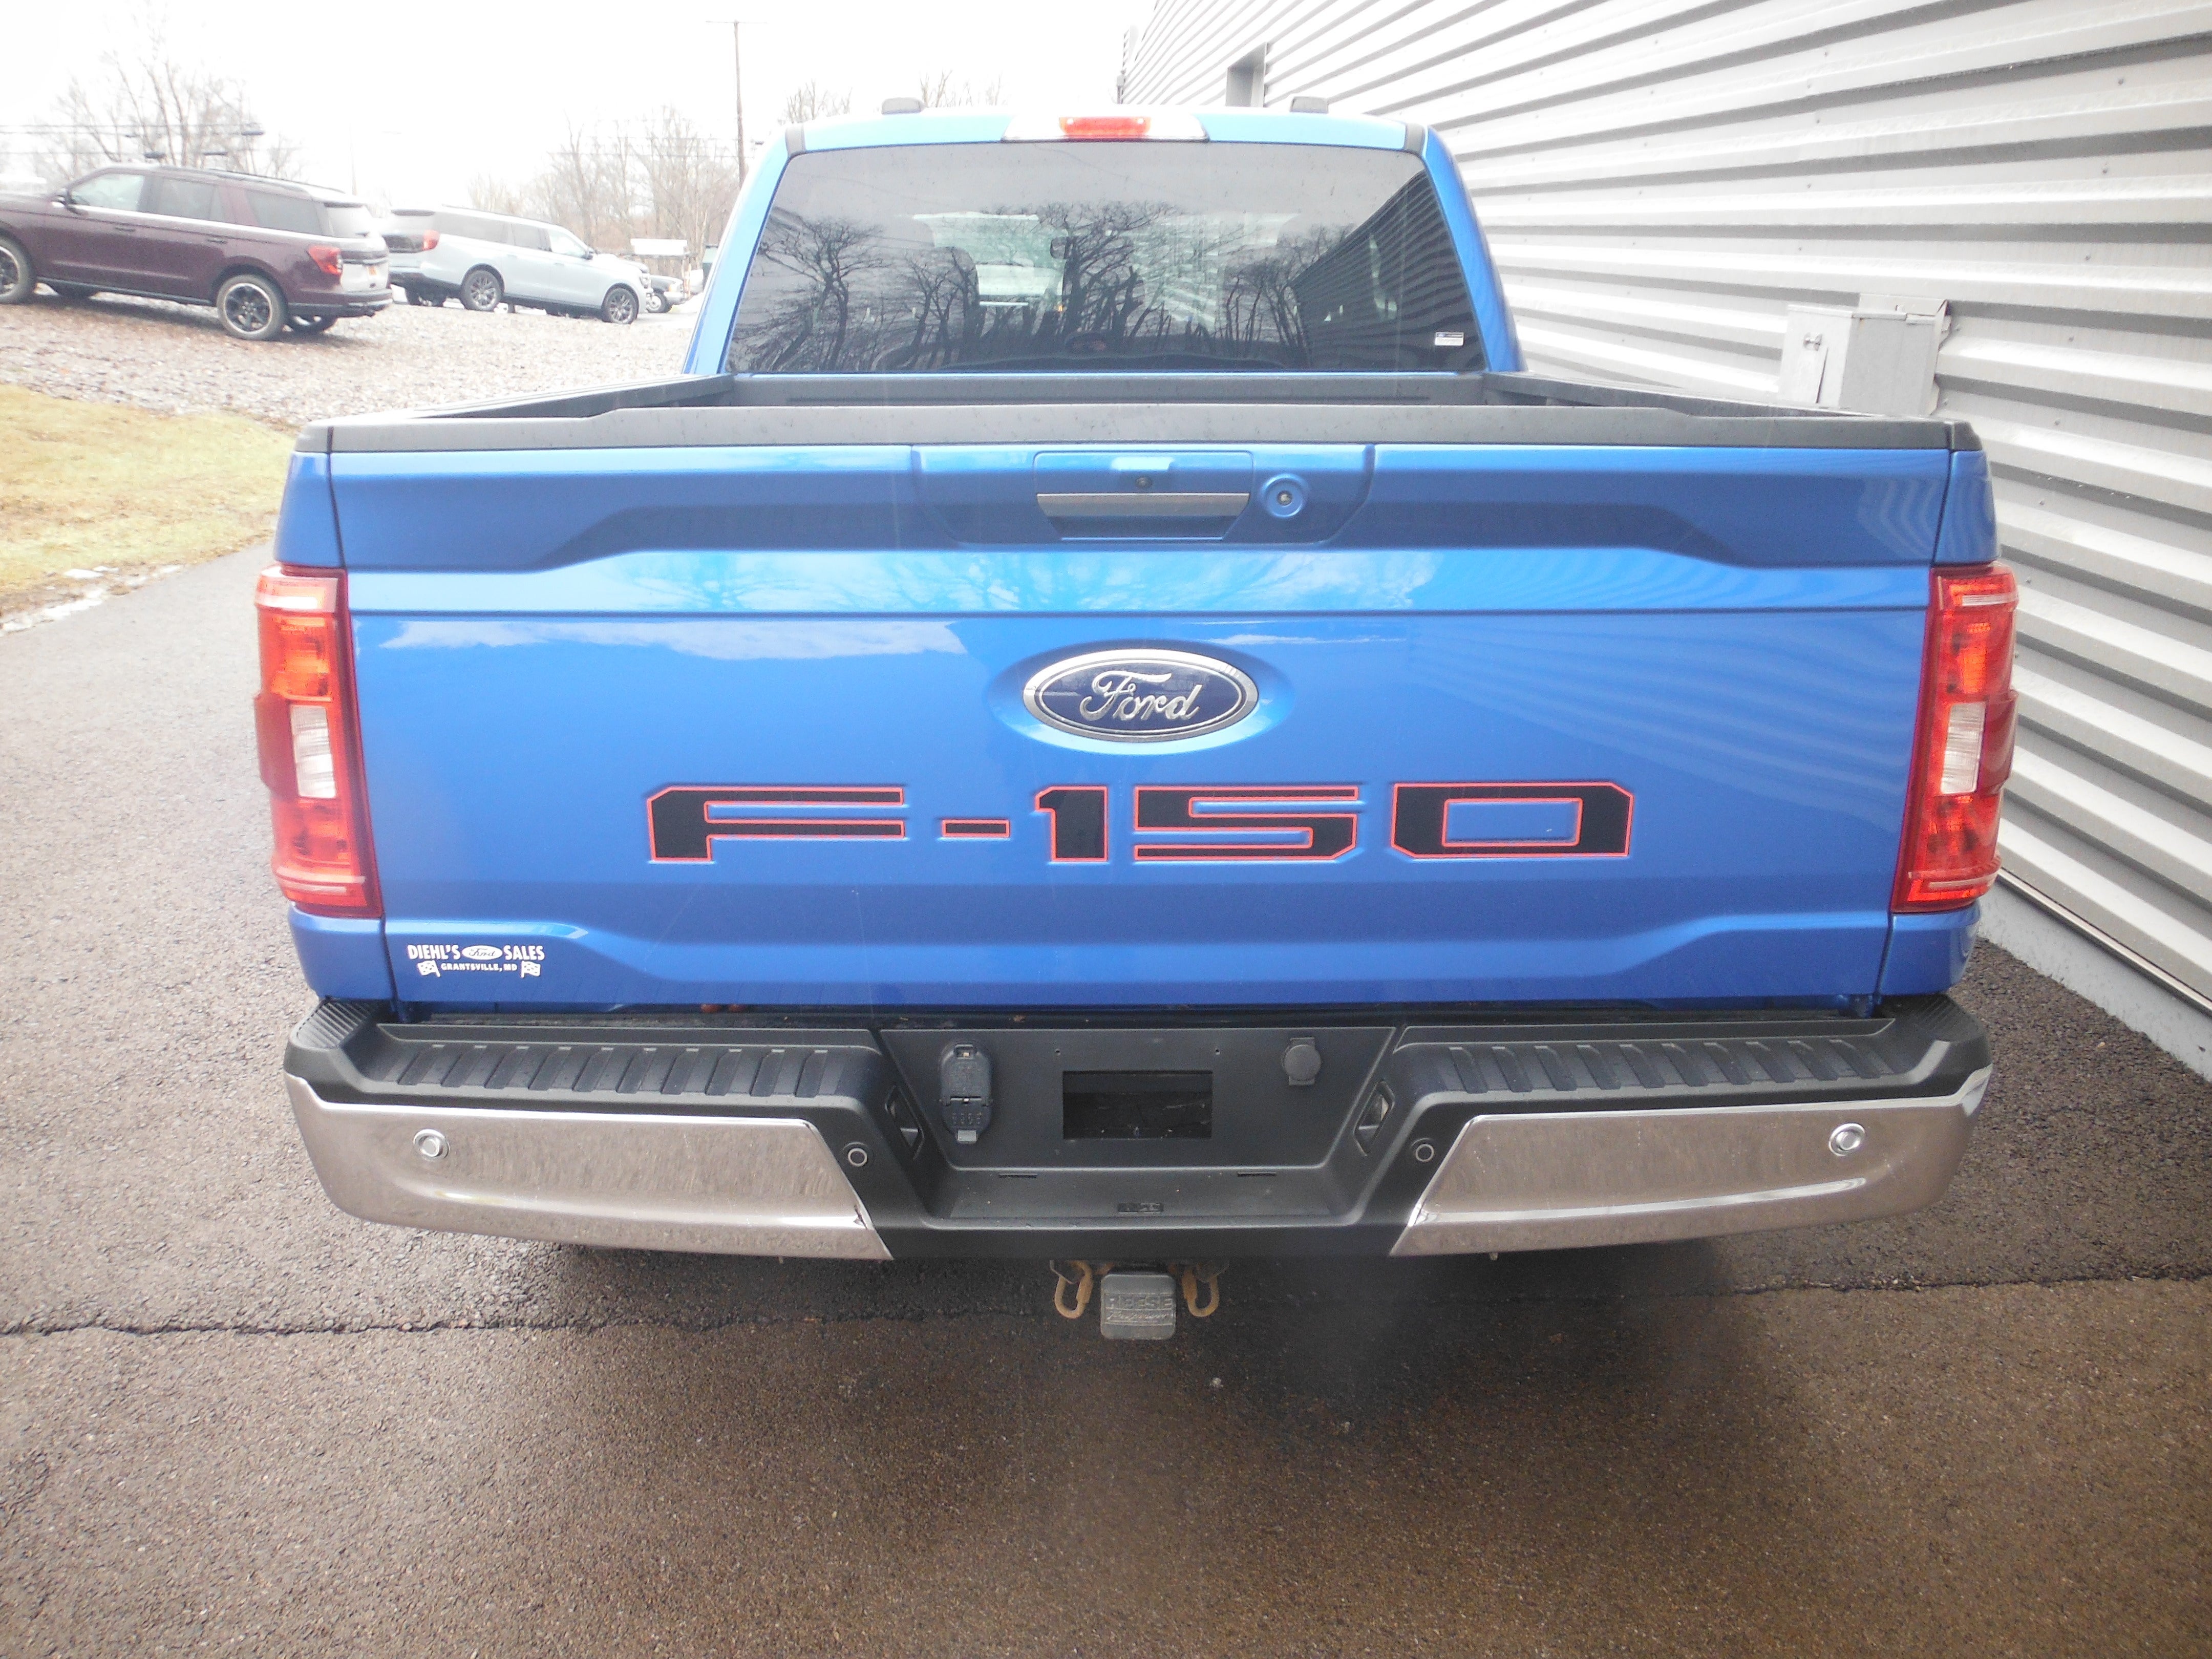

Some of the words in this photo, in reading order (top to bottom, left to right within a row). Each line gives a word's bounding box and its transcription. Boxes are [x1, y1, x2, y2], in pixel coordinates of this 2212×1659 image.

[1079, 670, 1203, 721] Ford
[647, 782, 1633, 861] F-150
[408, 945, 461, 960] DIEHL'S
[503, 945, 545, 960] SALES
[441, 963, 503, 972] GRANTSVILLE,
[504, 963, 518, 971] MD
